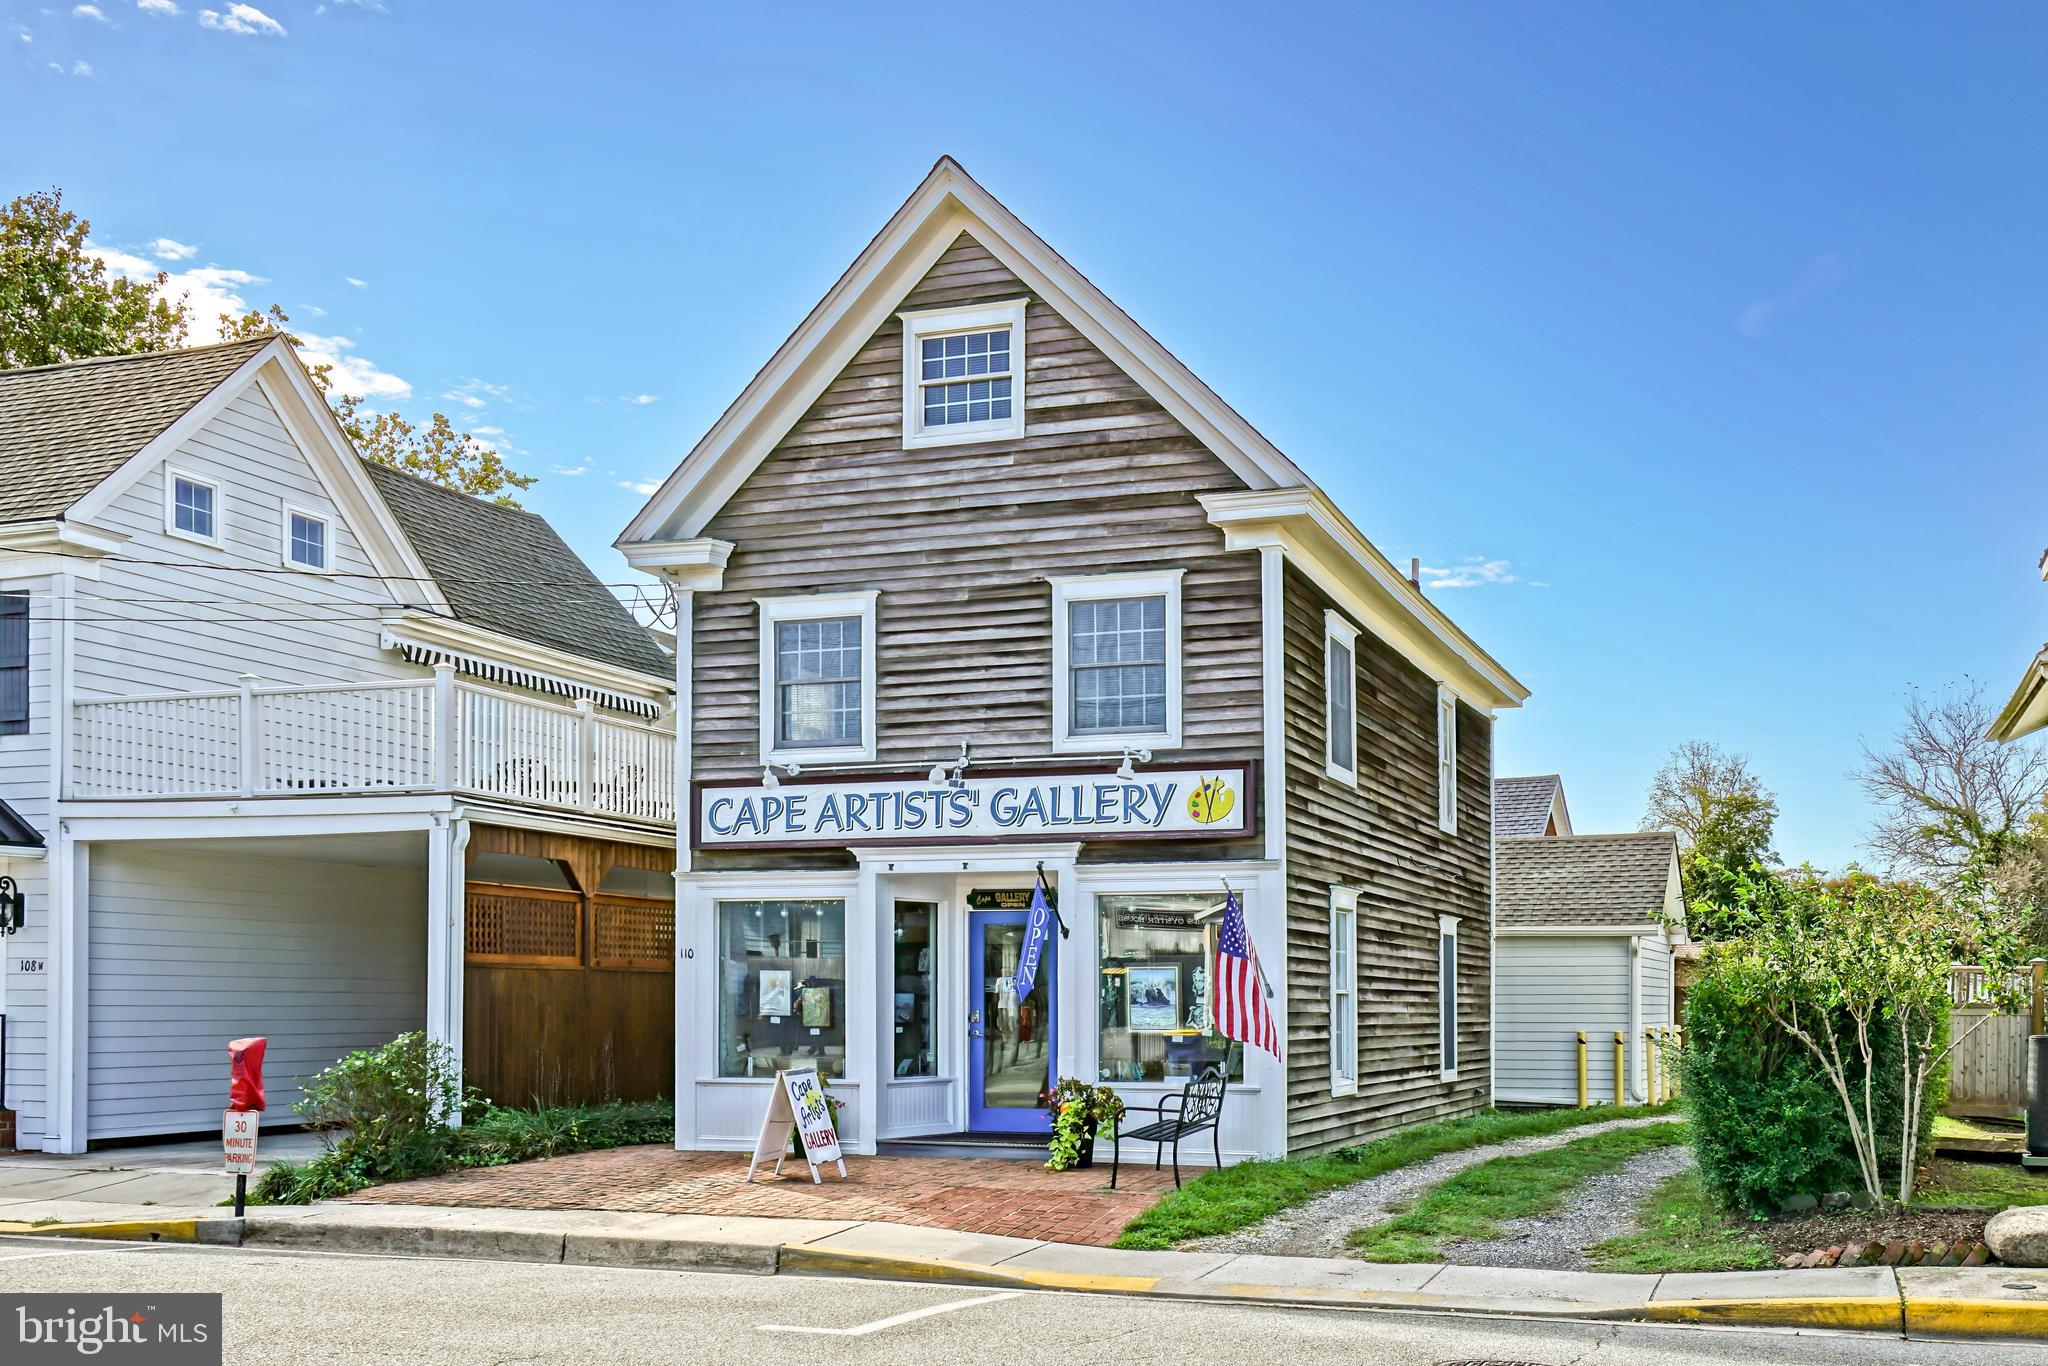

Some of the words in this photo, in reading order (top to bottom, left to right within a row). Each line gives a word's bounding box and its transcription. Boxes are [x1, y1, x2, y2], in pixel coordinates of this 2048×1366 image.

[708, 794, 807, 835] CAPE
[814, 789, 980, 834] ARTISTS'
[990, 783, 1177, 827] GALLERY
[995, 892, 1030, 902] GALLERY
[680, 948, 694, 959] 110
[1021, 908, 1046, 989] OPEN
[20, 960, 37, 972] 108
[791, 1078, 813, 1101] Cape
[234, 1121, 247, 1133] 30
[225, 1138, 253, 1149] MINUTE
[804, 1128, 837, 1150] GALLERY
[225, 1153, 252, 1164] PARKING
